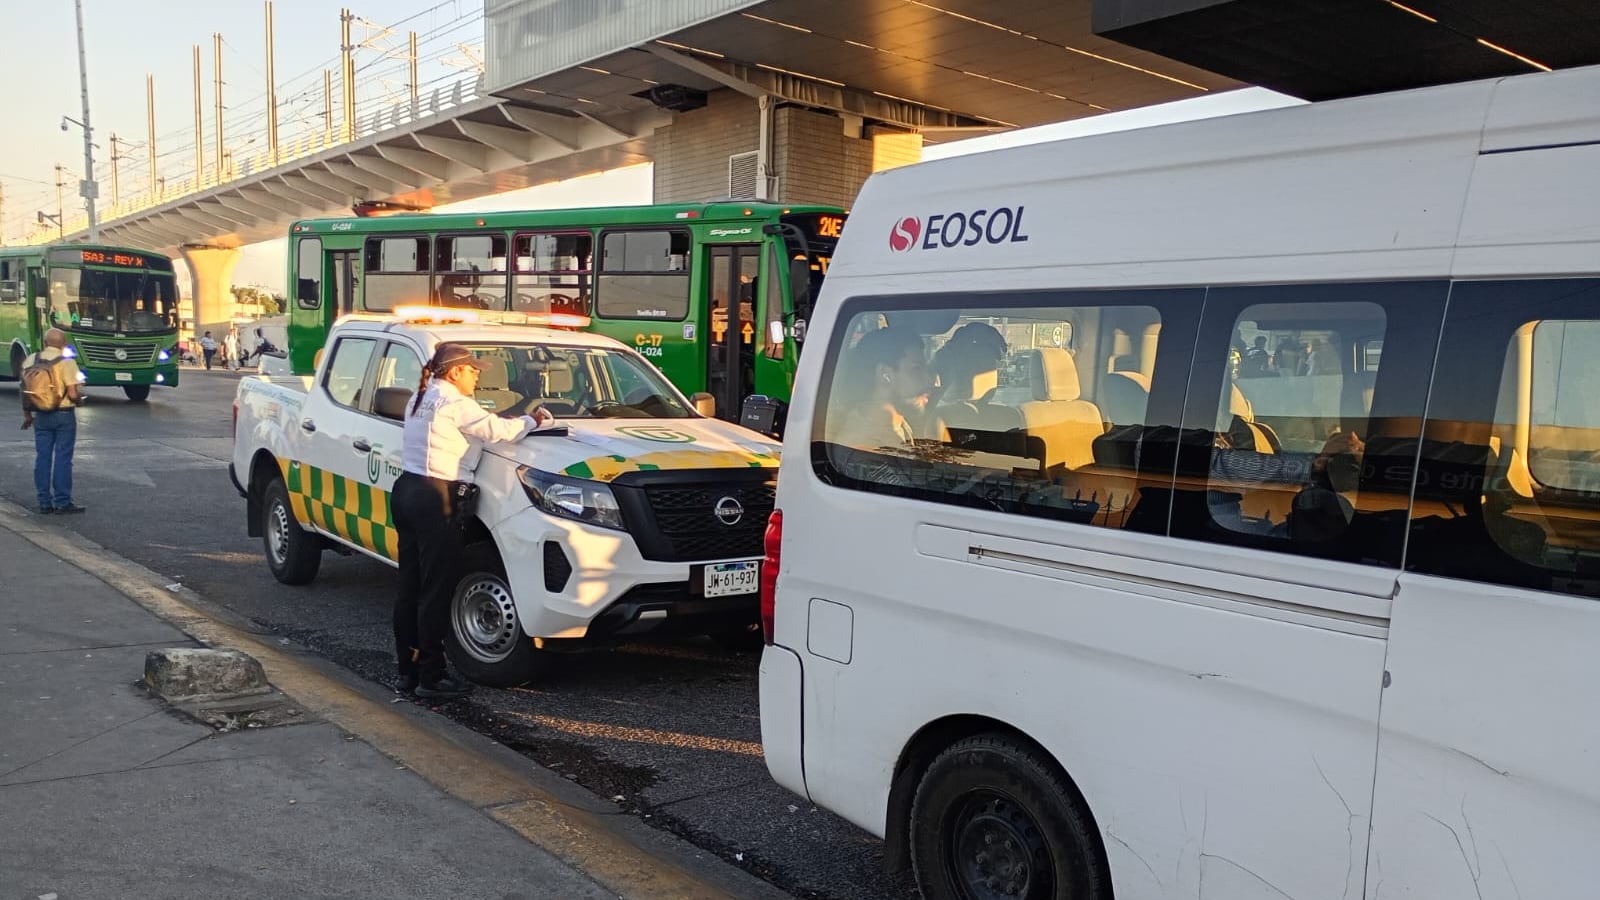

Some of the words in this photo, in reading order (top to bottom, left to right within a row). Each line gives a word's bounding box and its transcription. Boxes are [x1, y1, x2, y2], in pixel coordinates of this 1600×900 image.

[922, 206, 1028, 250] EOSOL
[635, 334, 663, 347] C-17
[708, 571, 756, 588] JW-61-937
